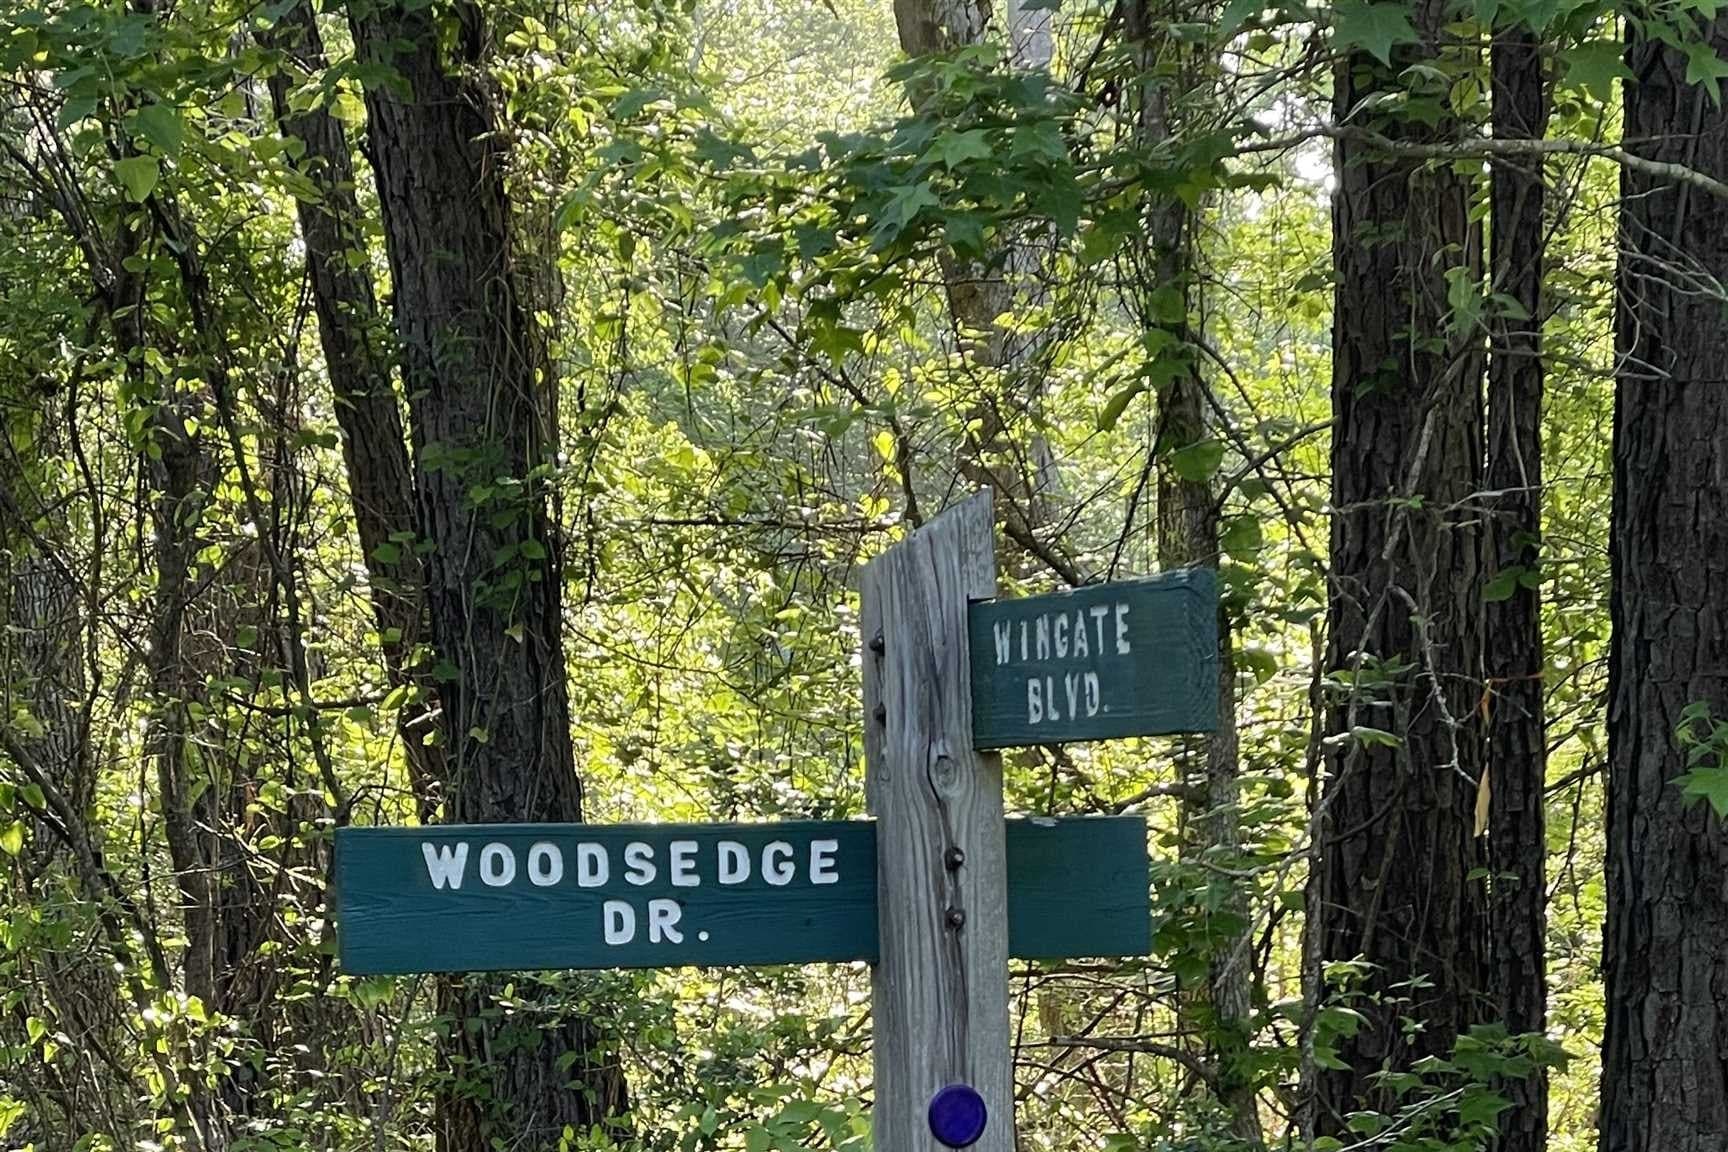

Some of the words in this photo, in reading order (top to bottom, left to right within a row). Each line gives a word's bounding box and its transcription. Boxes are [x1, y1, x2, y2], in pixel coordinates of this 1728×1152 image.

[993, 602, 1131, 666] WINGATE
[1027, 671, 1110, 725] BLVD.
[421, 839, 840, 891] WOODSEDGE
[603, 898, 711, 946] DR.
